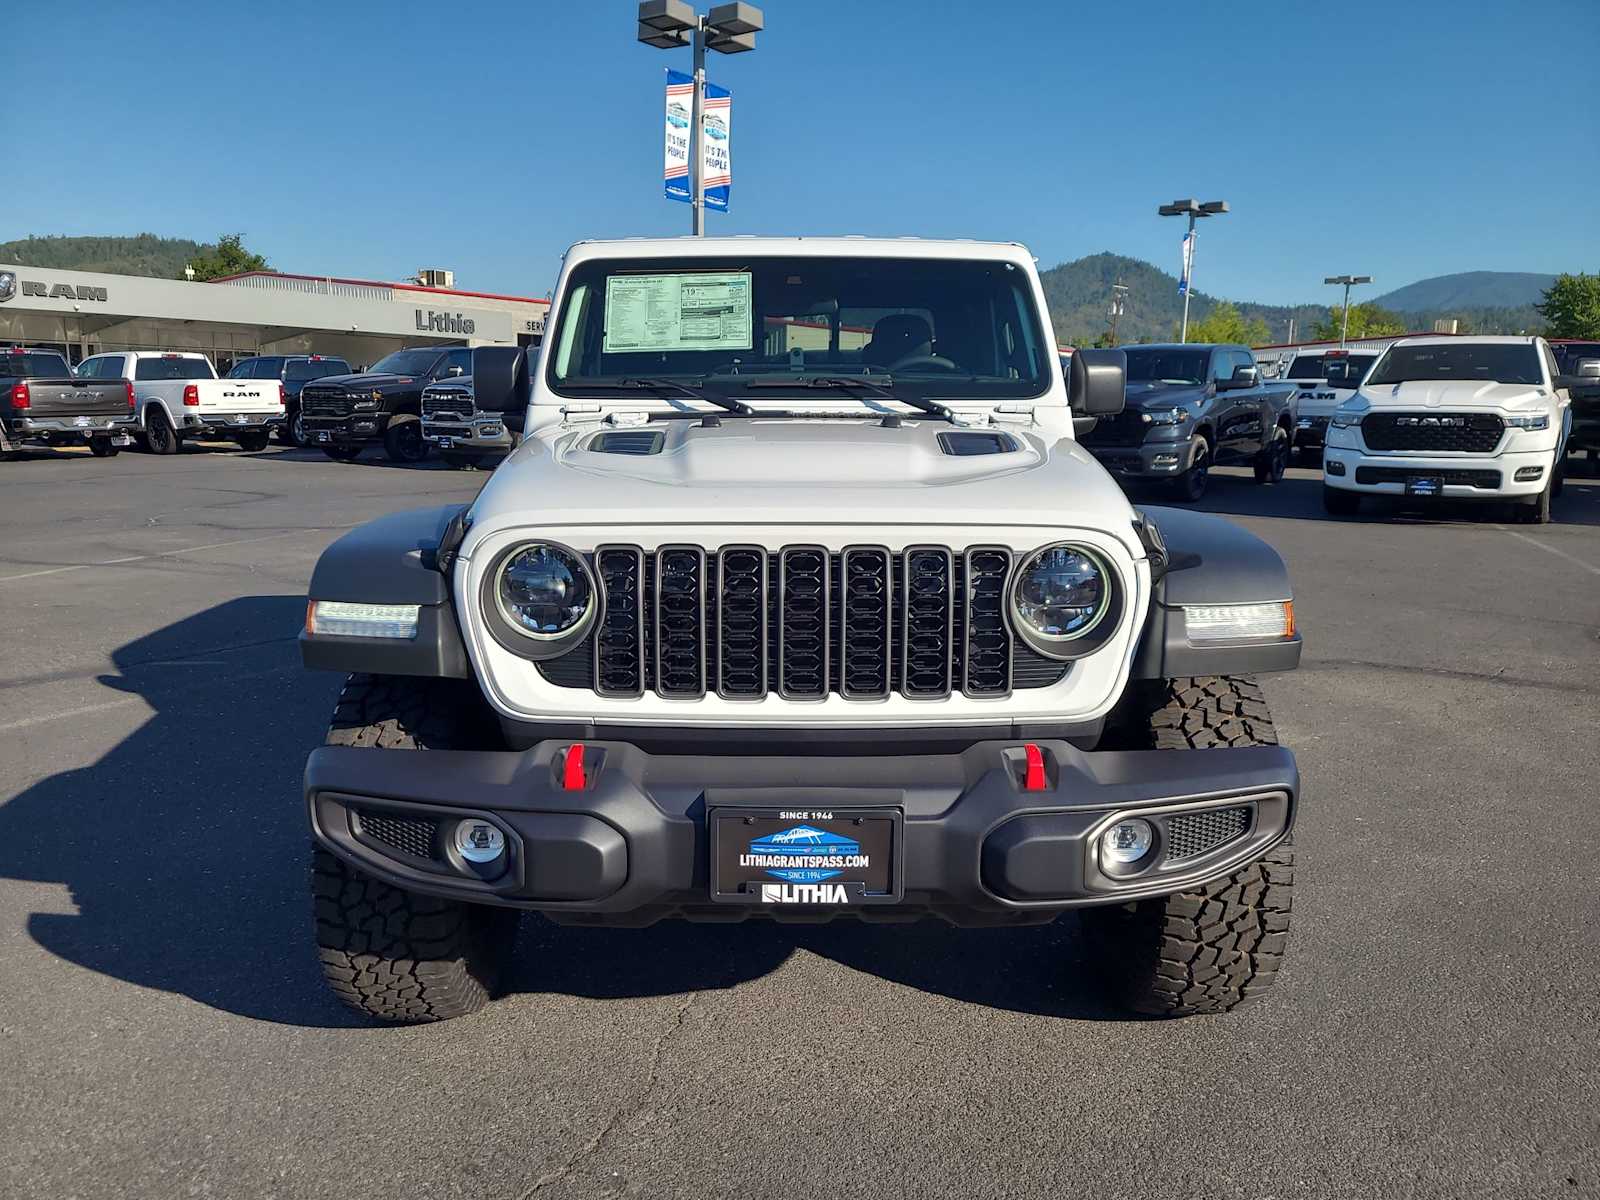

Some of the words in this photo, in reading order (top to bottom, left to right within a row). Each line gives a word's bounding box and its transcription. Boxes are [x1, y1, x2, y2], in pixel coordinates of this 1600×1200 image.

[667, 145, 686, 160] PEOPLE
[705, 156, 728, 170] PEOPLE
[21, 280, 108, 302] RAM
[415, 309, 475, 335] Lithia
[1298, 392, 1336, 400] AM
[1397, 417, 1465, 426] RAM
[779, 811, 809, 820] SINCE
[811, 811, 834, 820] 1946
[739, 854, 870, 868] LITHIAGRANTSPASS.COM
[787, 871, 805, 880] SINCE
[807, 871, 821, 880] 1994
[782, 884, 849, 904] LITHIA
